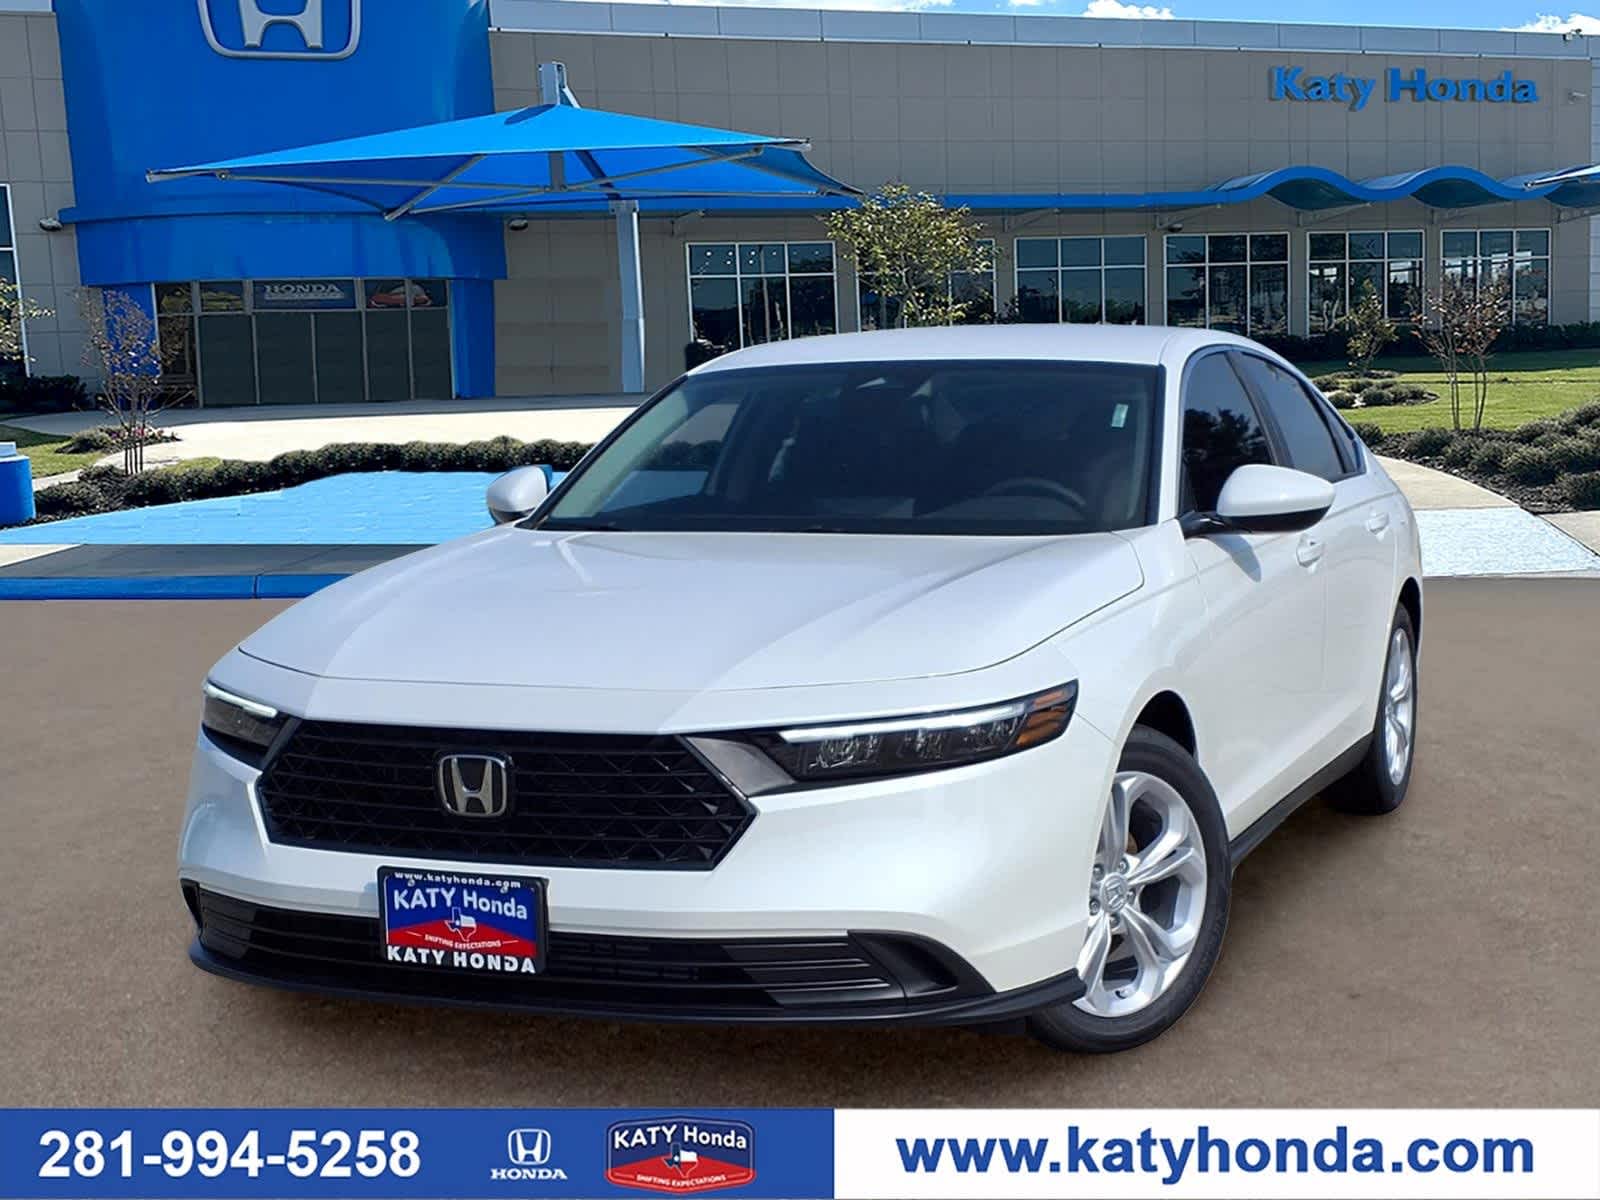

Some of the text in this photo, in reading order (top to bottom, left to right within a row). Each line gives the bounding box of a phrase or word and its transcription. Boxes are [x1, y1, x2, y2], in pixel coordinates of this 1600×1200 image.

[1270, 65, 1539, 111] Katy Honda
[263, 283, 341, 295] HONDA
[394, 871, 521, 889] www.katyhonda.com
[393, 887, 528, 920] KATY Honda
[386, 945, 536, 974] KATY HONDA
